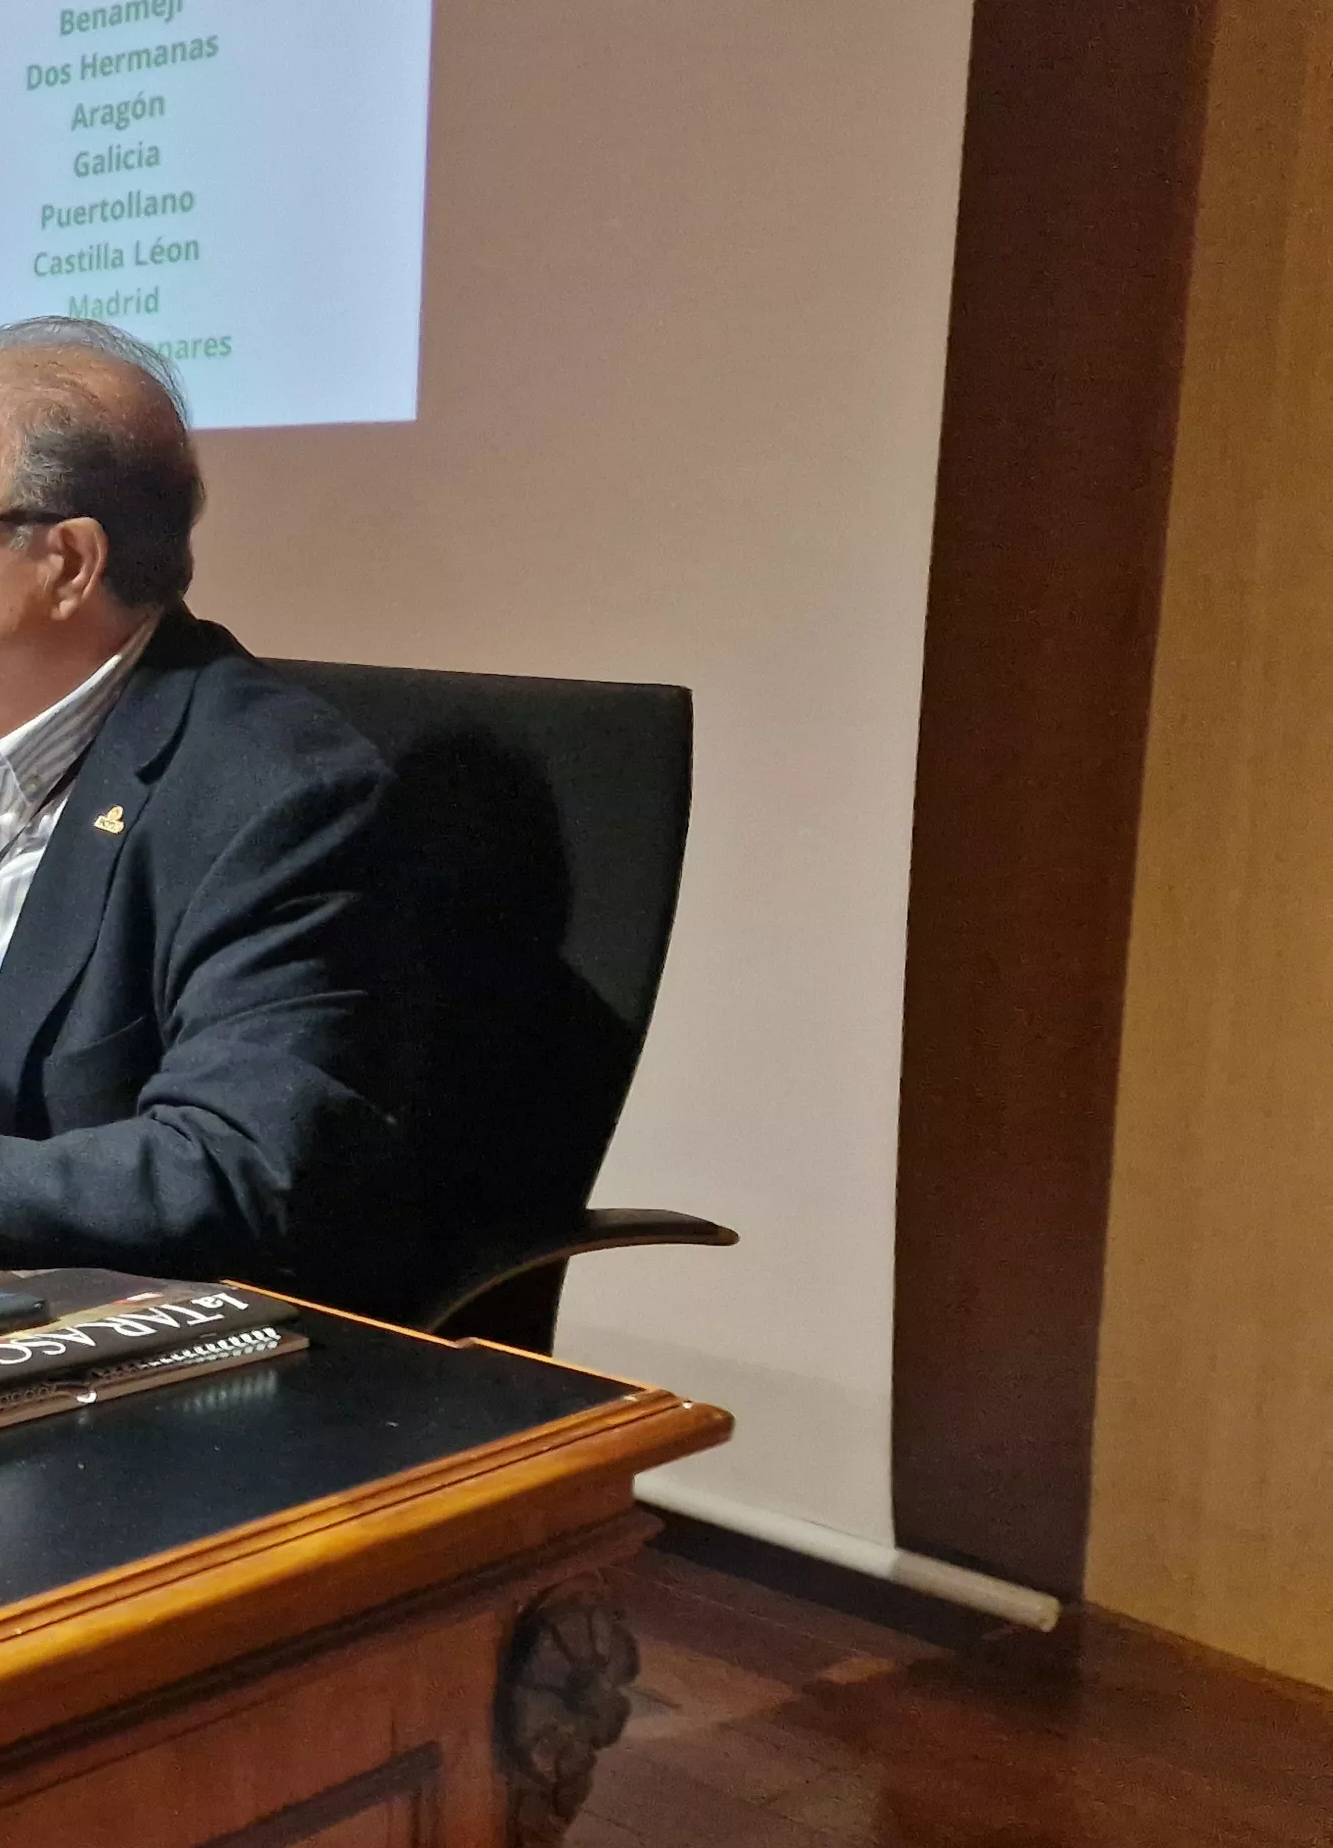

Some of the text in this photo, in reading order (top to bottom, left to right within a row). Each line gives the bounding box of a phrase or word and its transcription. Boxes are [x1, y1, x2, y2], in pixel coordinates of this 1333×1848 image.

[26, 34, 220, 91] Dos Hermanas
[71, 91, 166, 132] Aragón
[73, 141, 161, 178] Galicia
[40, 190, 194, 230] Puertollano
[33, 236, 200, 278] Castilla Léon
[68, 286, 160, 319] Madrid
[155, 335, 233, 361] nares
